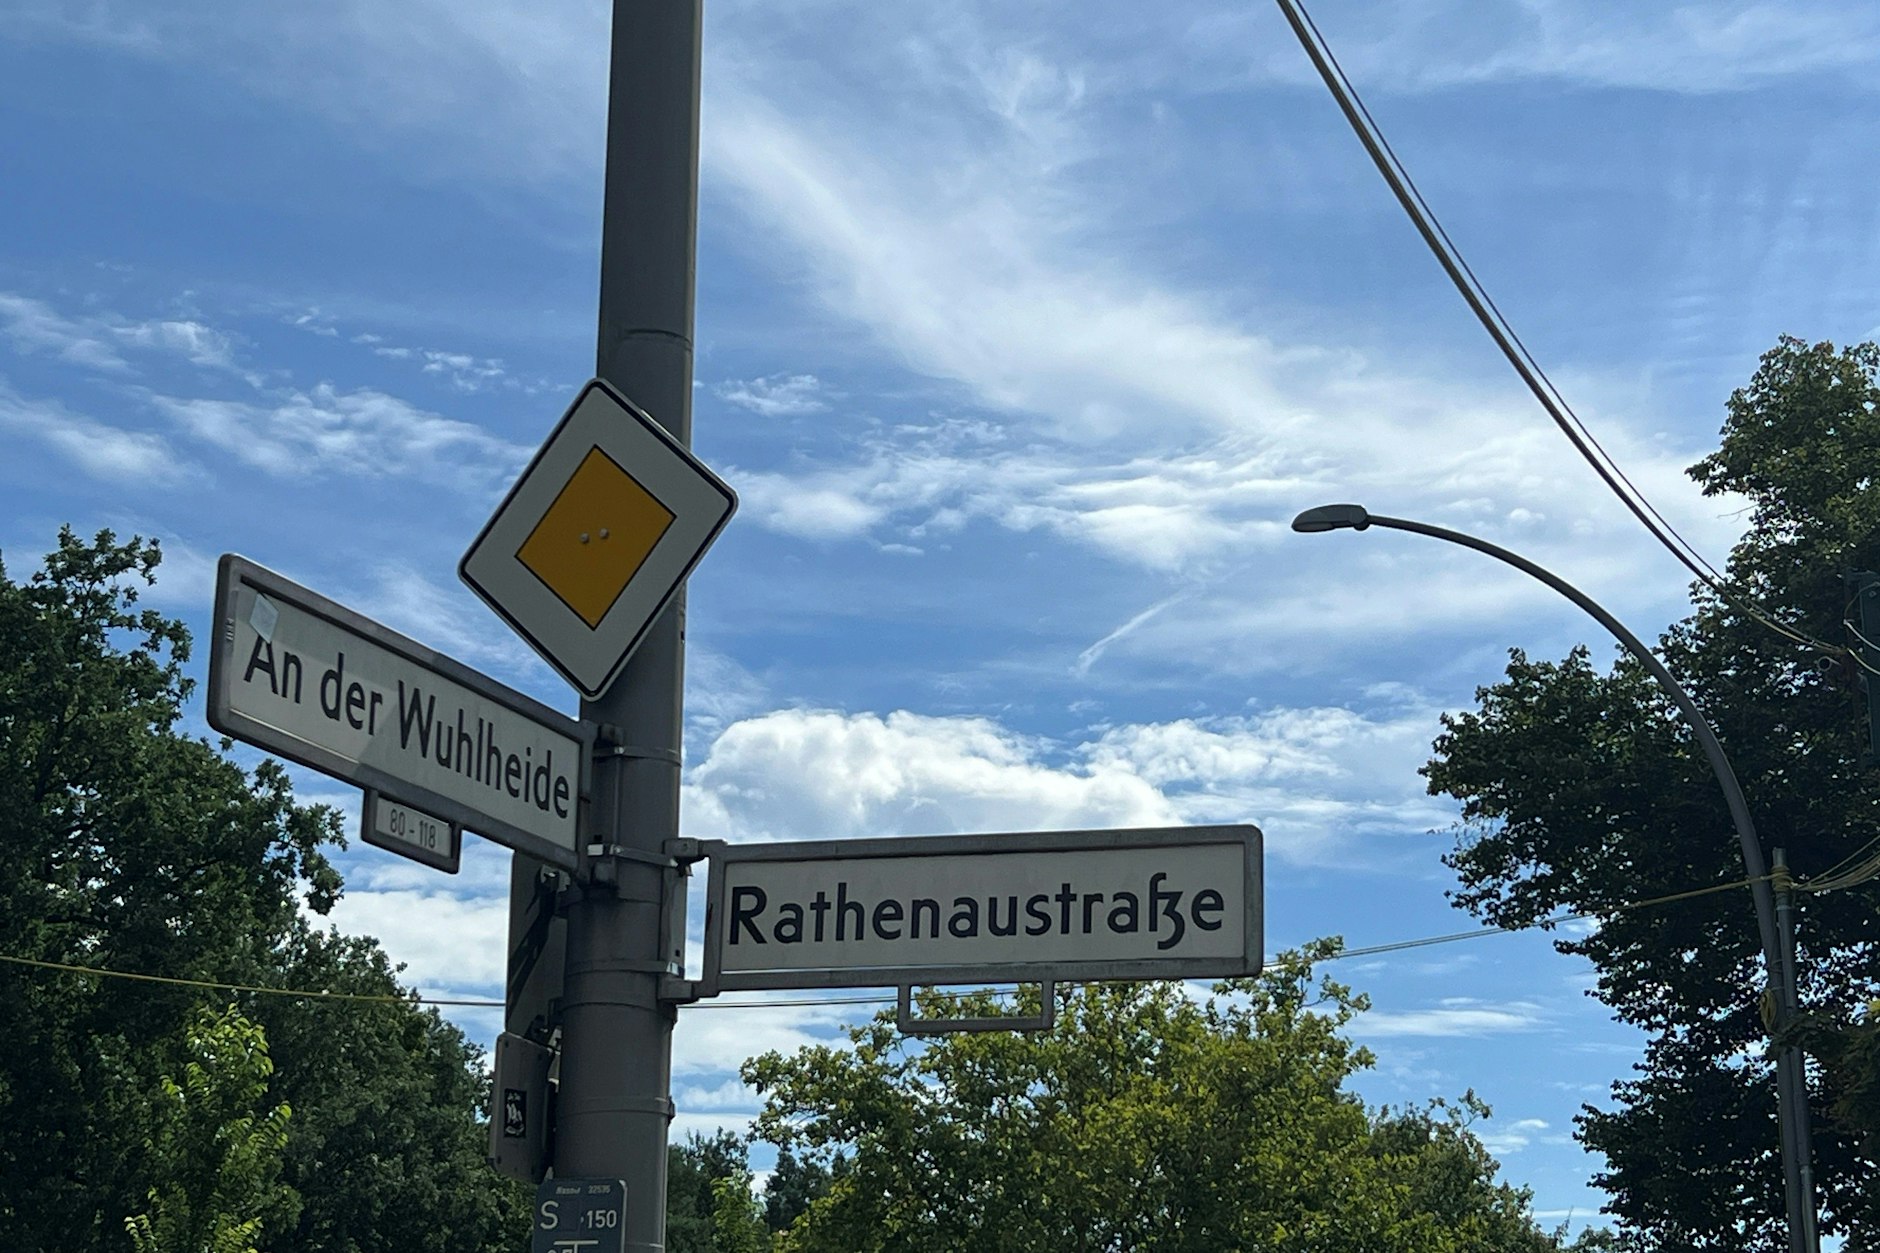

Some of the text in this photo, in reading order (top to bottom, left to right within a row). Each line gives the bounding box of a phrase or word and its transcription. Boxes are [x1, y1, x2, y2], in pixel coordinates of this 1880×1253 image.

[243, 635, 570, 819] An der Wuhlheide
[728, 871, 1225, 950] Rathenaustraße
[540, 1200, 559, 1230] S
